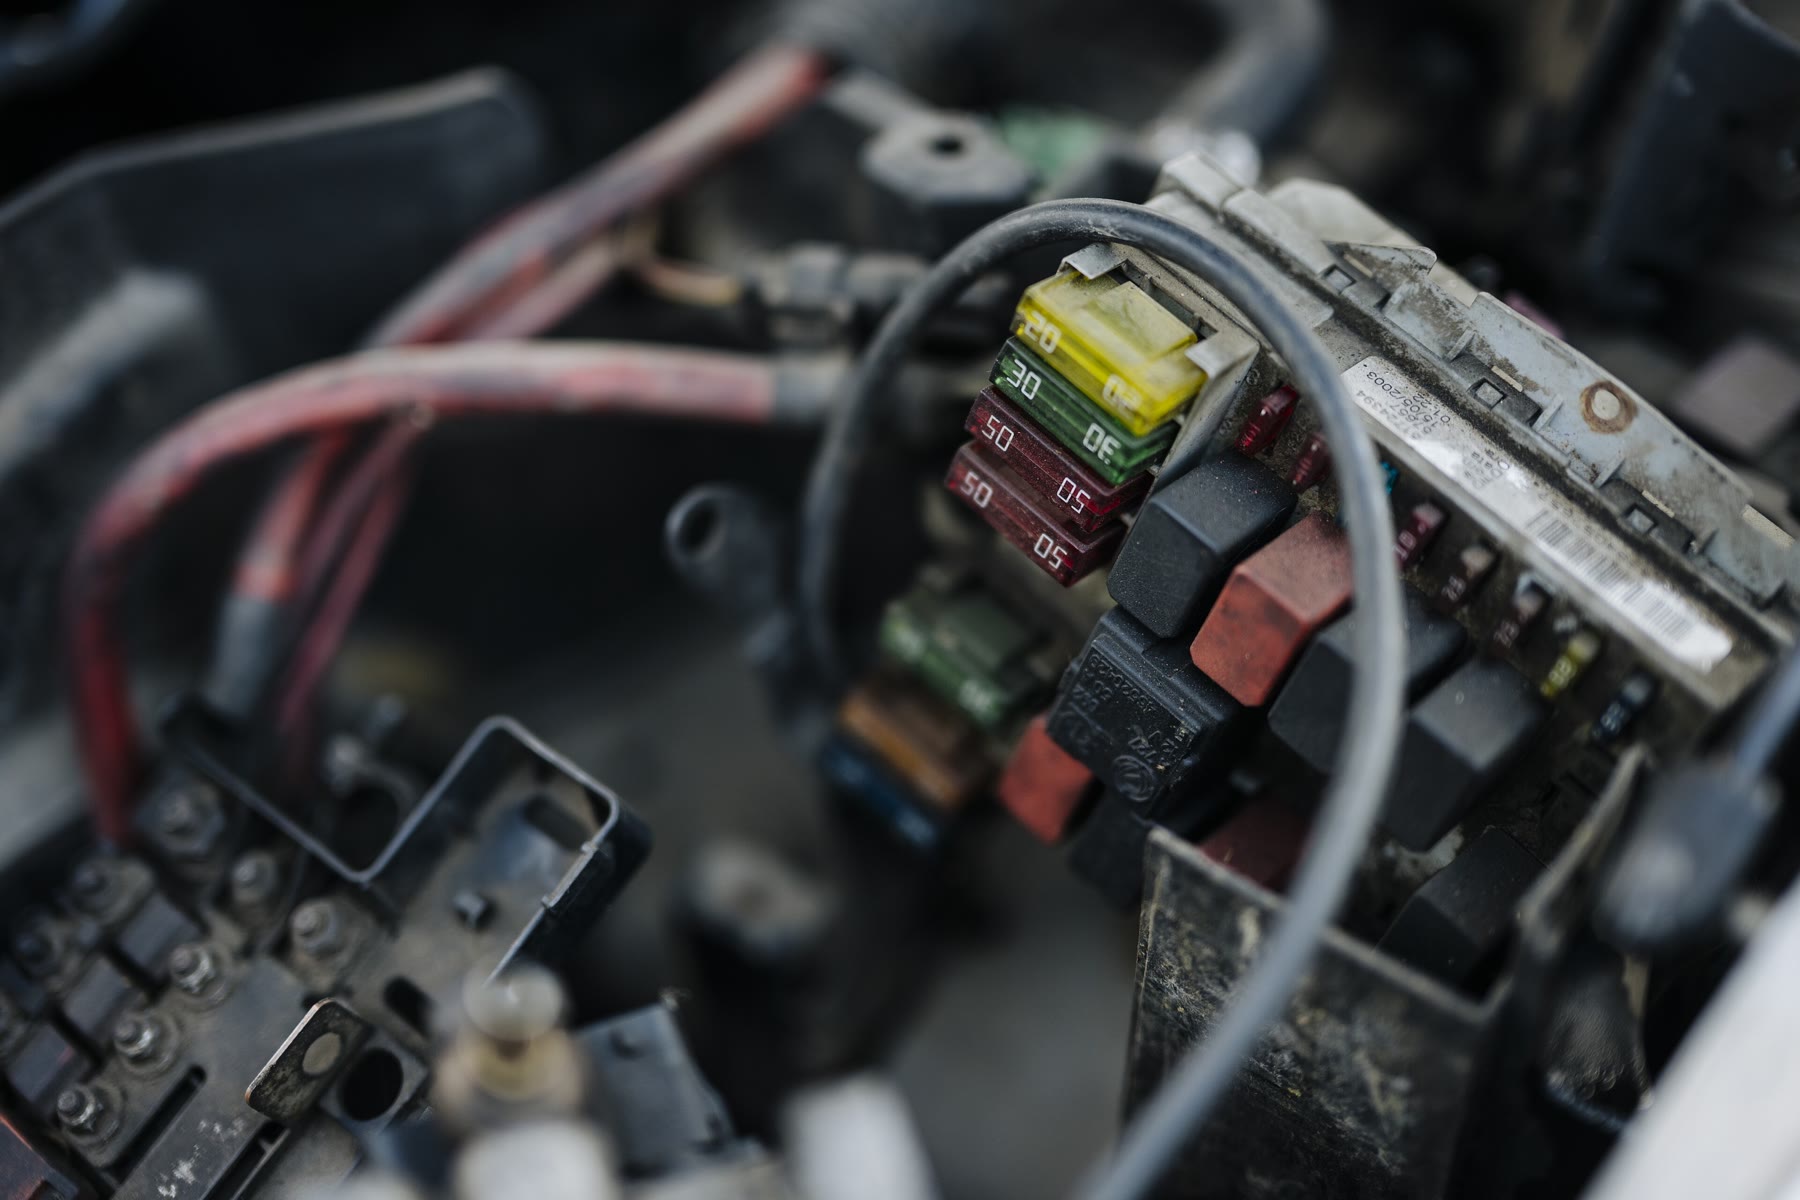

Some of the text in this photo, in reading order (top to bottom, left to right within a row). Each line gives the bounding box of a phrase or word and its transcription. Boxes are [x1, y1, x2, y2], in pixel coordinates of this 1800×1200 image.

[1024, 311, 1062, 354] 20
[1006, 358, 1041, 400] 30
[1366, 370, 1438, 426] 15/05/2003
[1411, 392, 1451, 424] 01:22
[982, 414, 1015, 452] 50
[1083, 422, 1121, 465] 30
[960, 472, 993, 508] 50
[1057, 477, 1091, 514] 50
[1033, 533, 1068, 570] 50
